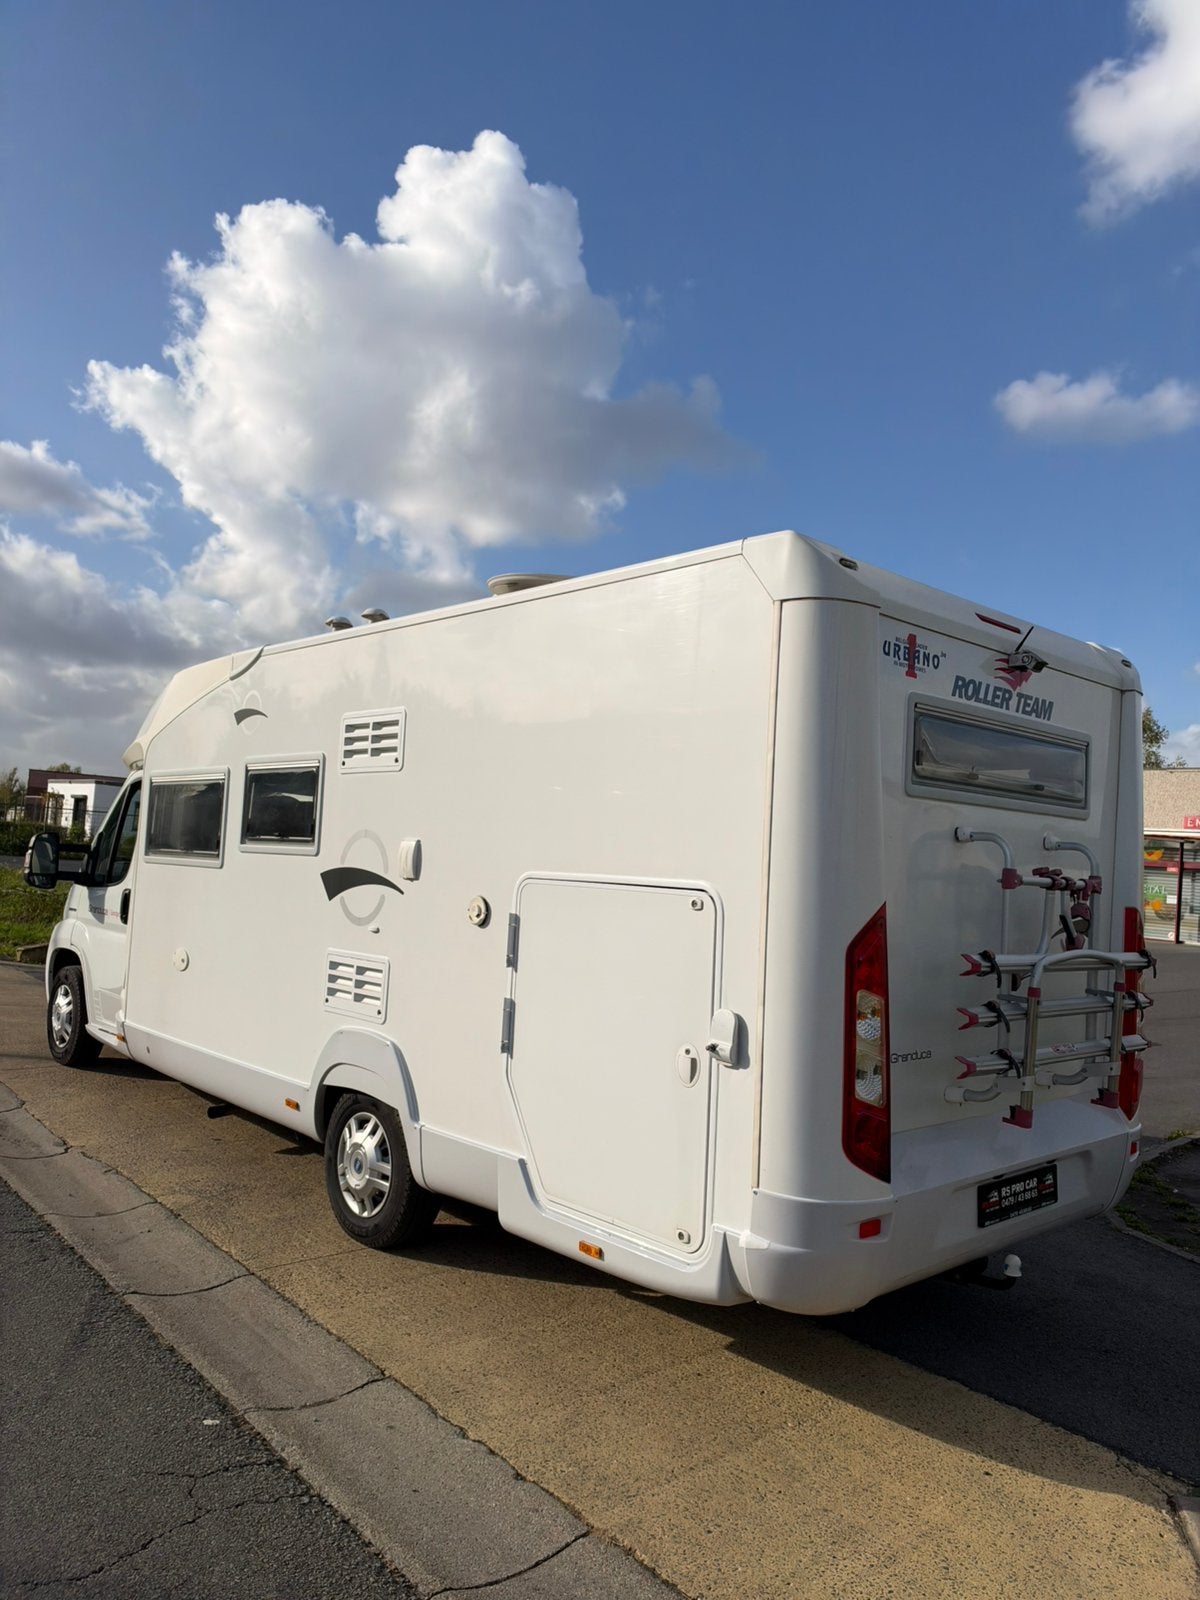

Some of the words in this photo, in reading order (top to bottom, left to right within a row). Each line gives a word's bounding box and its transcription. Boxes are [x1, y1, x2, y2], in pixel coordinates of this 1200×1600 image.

[882, 640, 941, 670] URBANO
[951, 675, 1014, 711] ROLLER
[1014, 691, 1055, 722] TEAM
[890, 1050, 932, 1064] Granduca
[1001, 1185, 1011, 1198] RS
[1011, 1182, 1025, 1195] PRO
[1025, 1177, 1038, 1190] CAR
